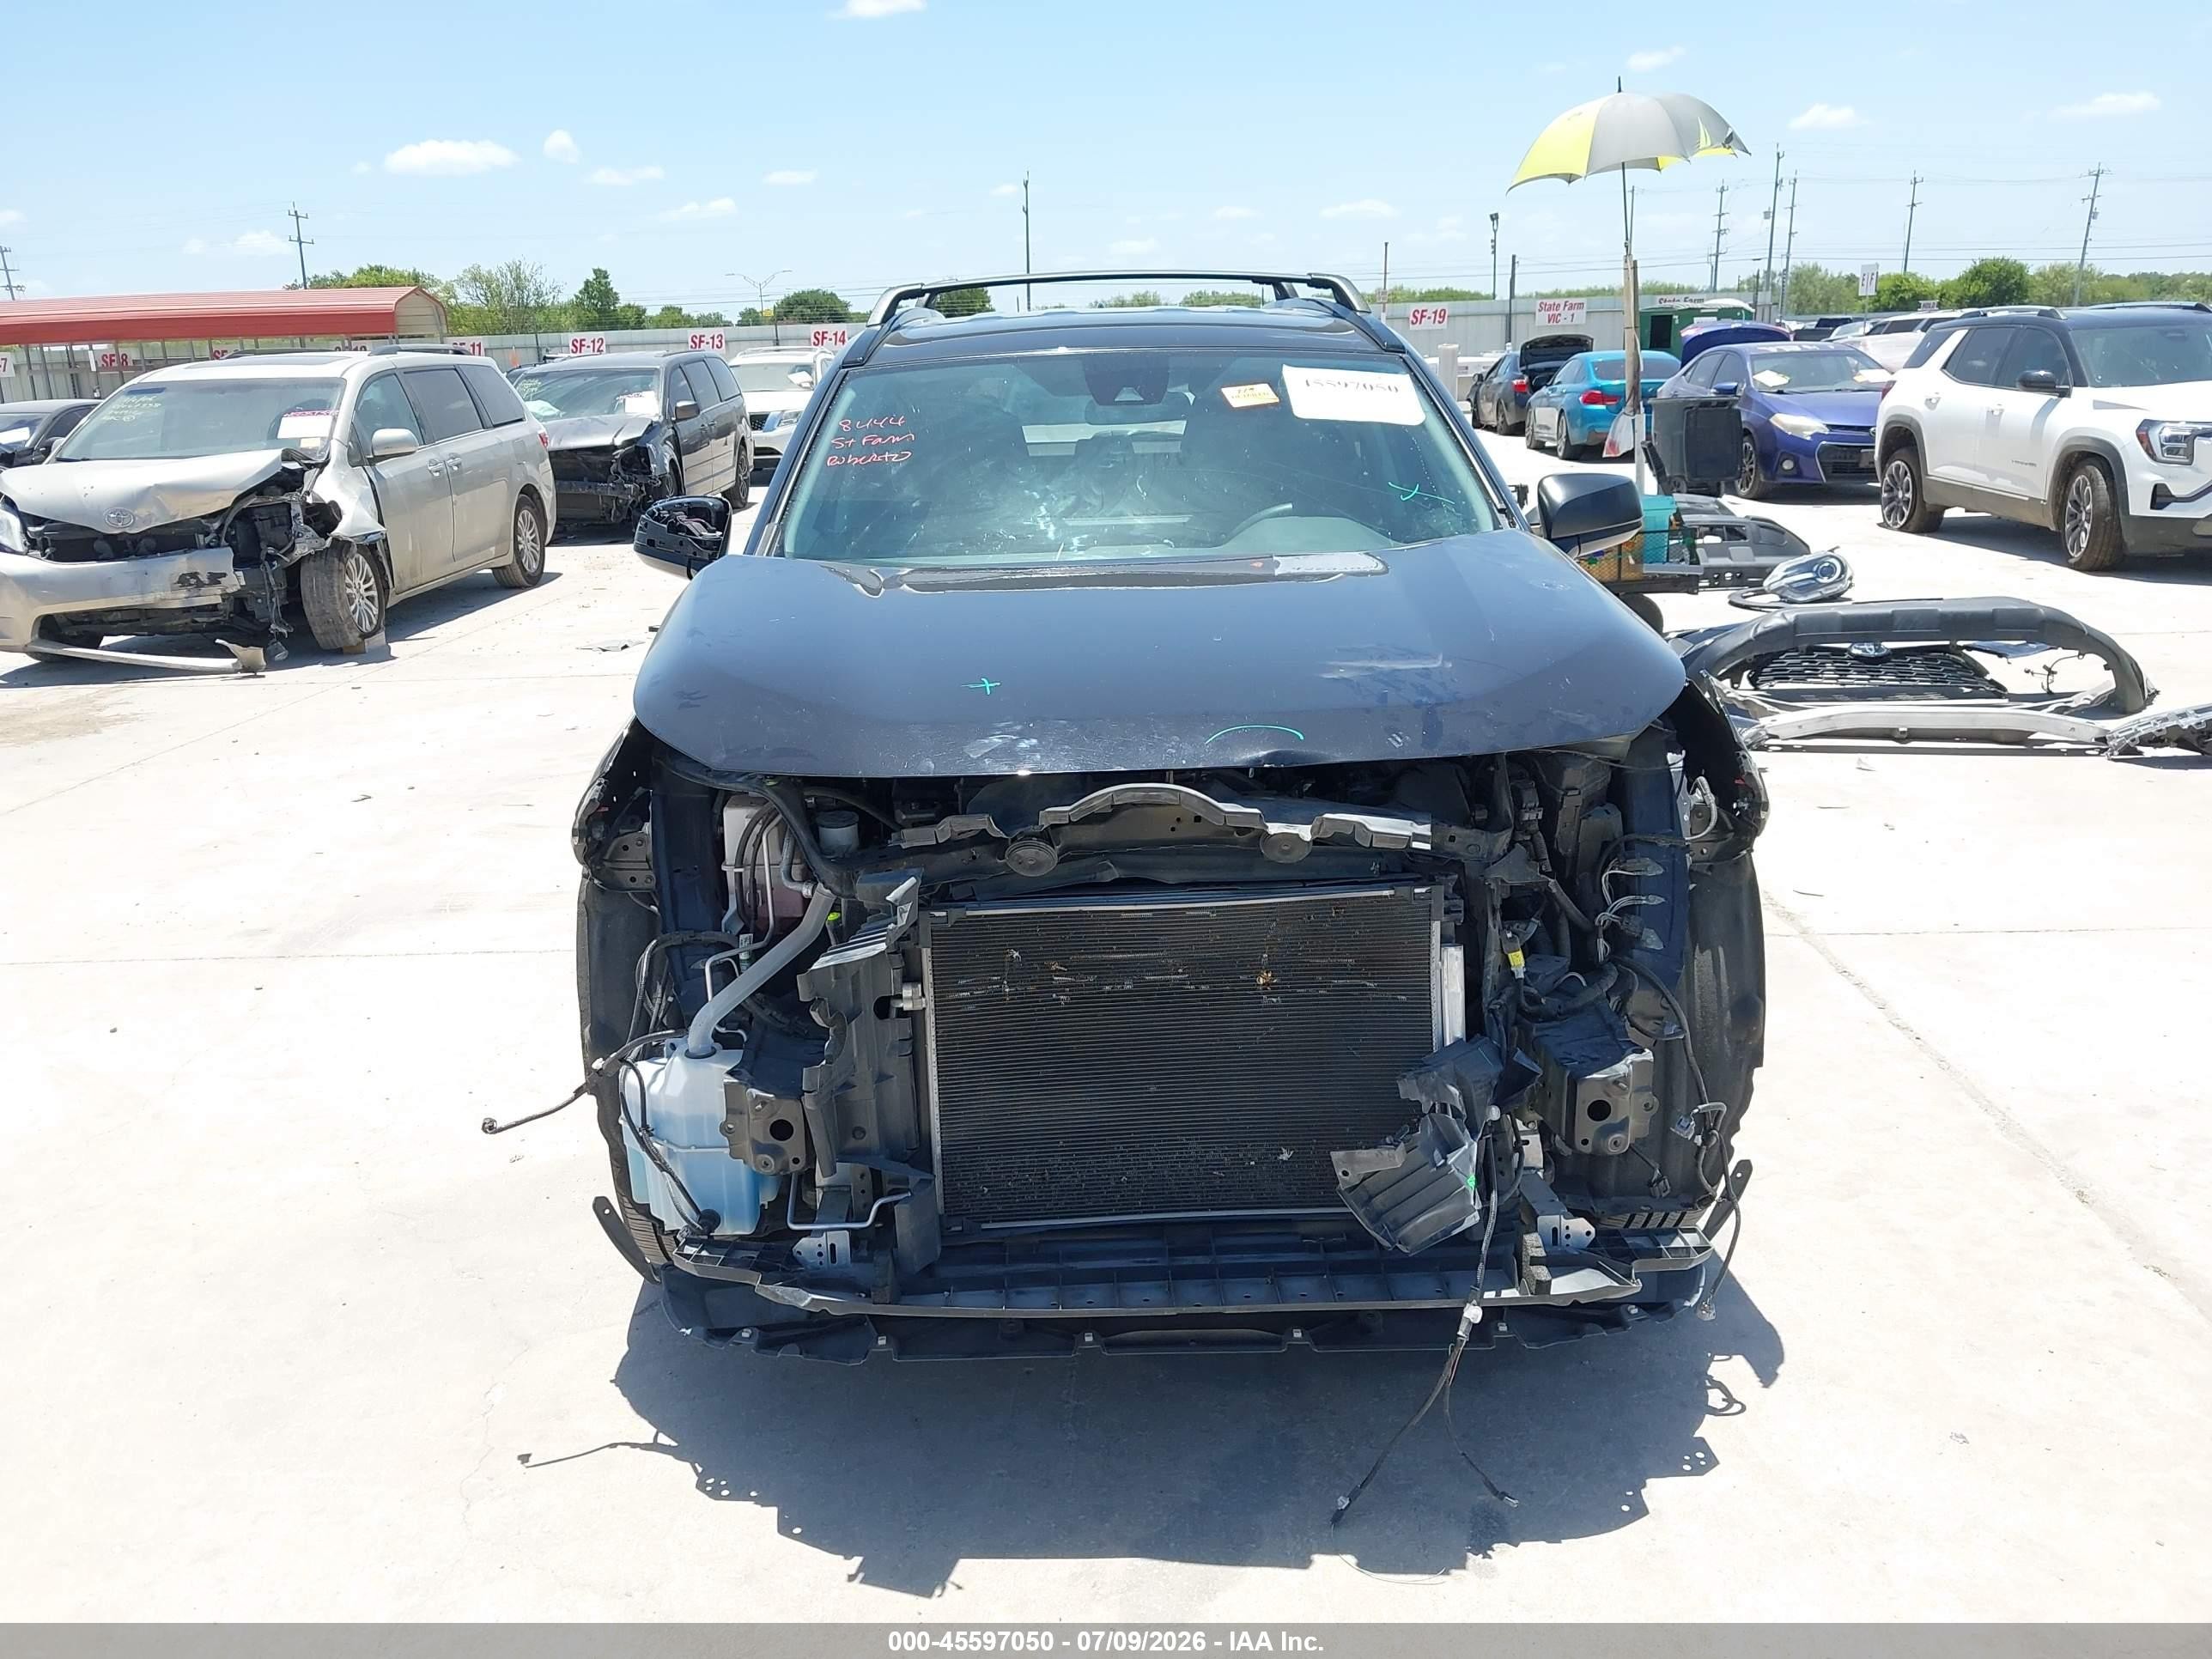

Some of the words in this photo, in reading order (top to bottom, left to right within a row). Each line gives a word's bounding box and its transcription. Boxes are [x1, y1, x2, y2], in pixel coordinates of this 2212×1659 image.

[1538, 301, 1561, 312] State
[1563, 301, 1585, 311] Farm
[1411, 308, 1447, 325] SF-19
[1547, 313, 1561, 324] VIC
[571, 337, 605, 354] SF-12
[690, 333, 723, 350] SF-13
[812, 330, 847, 346] SF-14
[101, 353, 128, 368] SF8
